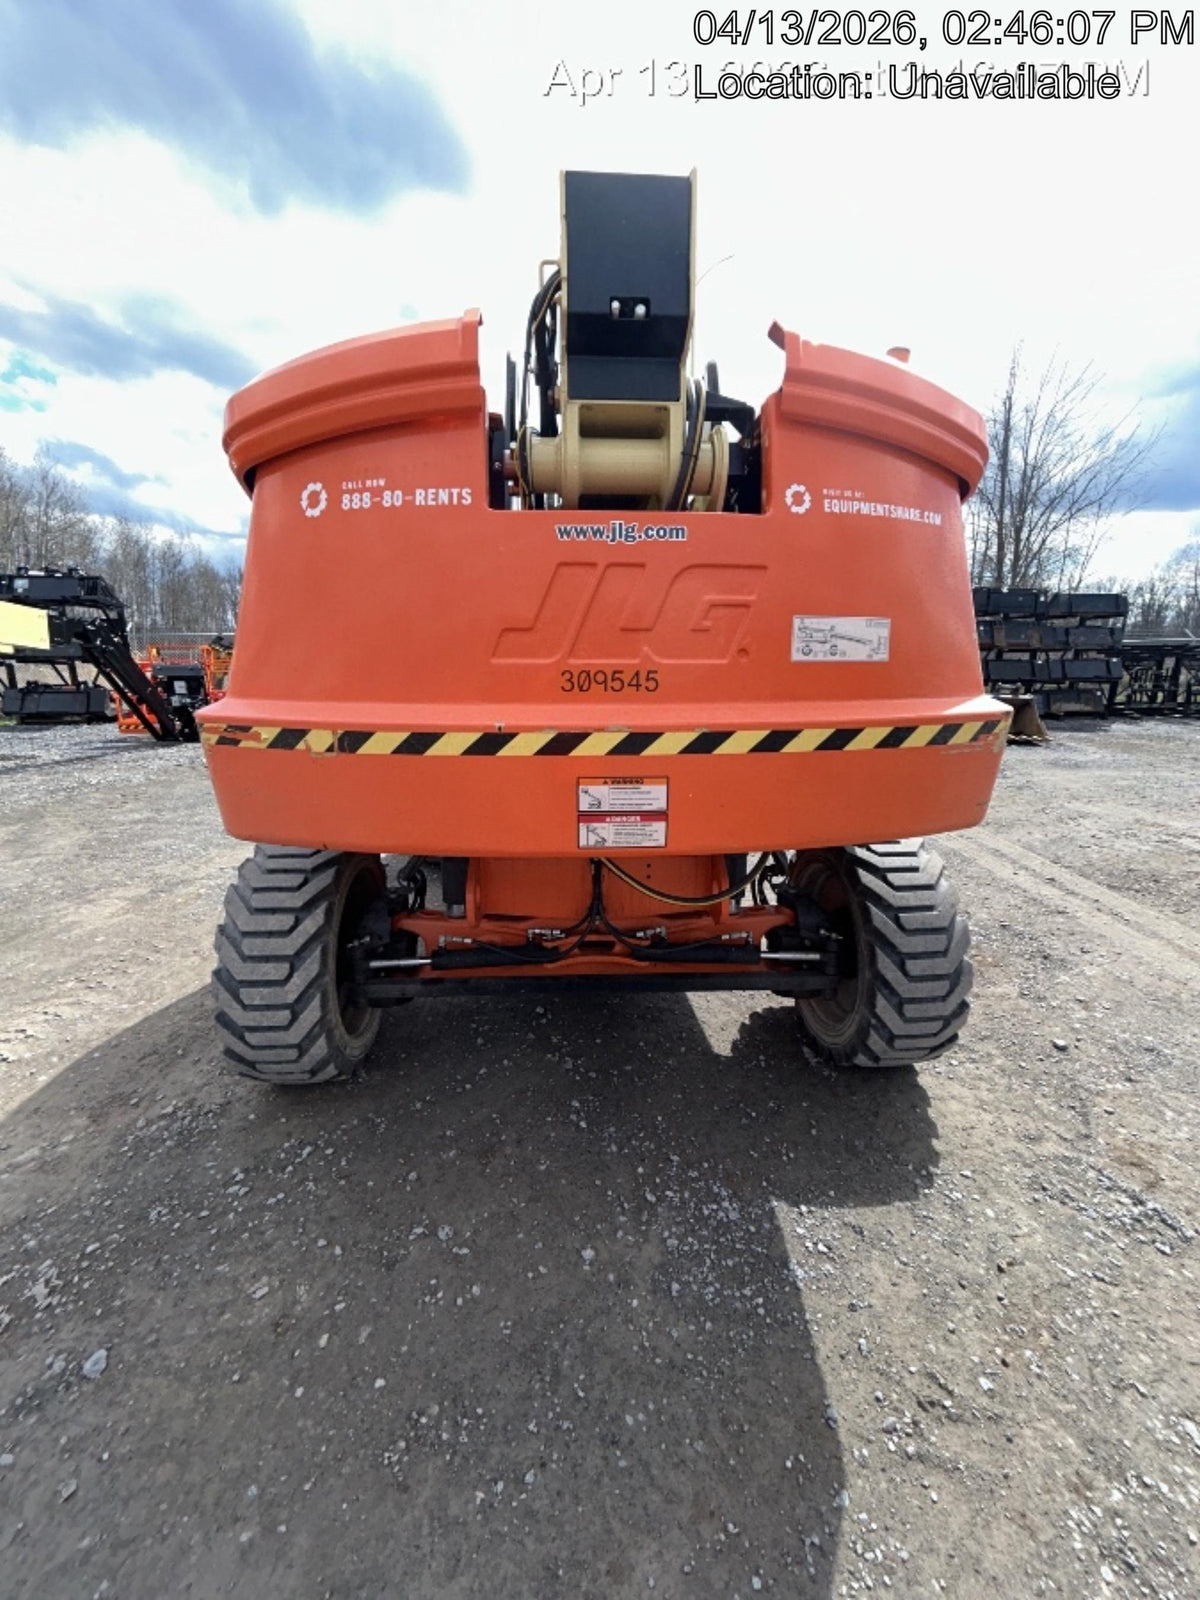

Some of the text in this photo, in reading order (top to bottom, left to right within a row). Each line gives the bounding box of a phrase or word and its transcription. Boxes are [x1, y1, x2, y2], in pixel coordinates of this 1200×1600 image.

[341, 487, 473, 511] 888-80-RENTS
[823, 499, 943, 526] EQUIPMENTSHARE.COM
[555, 521, 688, 544] www.jlg.com
[489, 560, 769, 665] JLG
[560, 669, 660, 693] 309545
